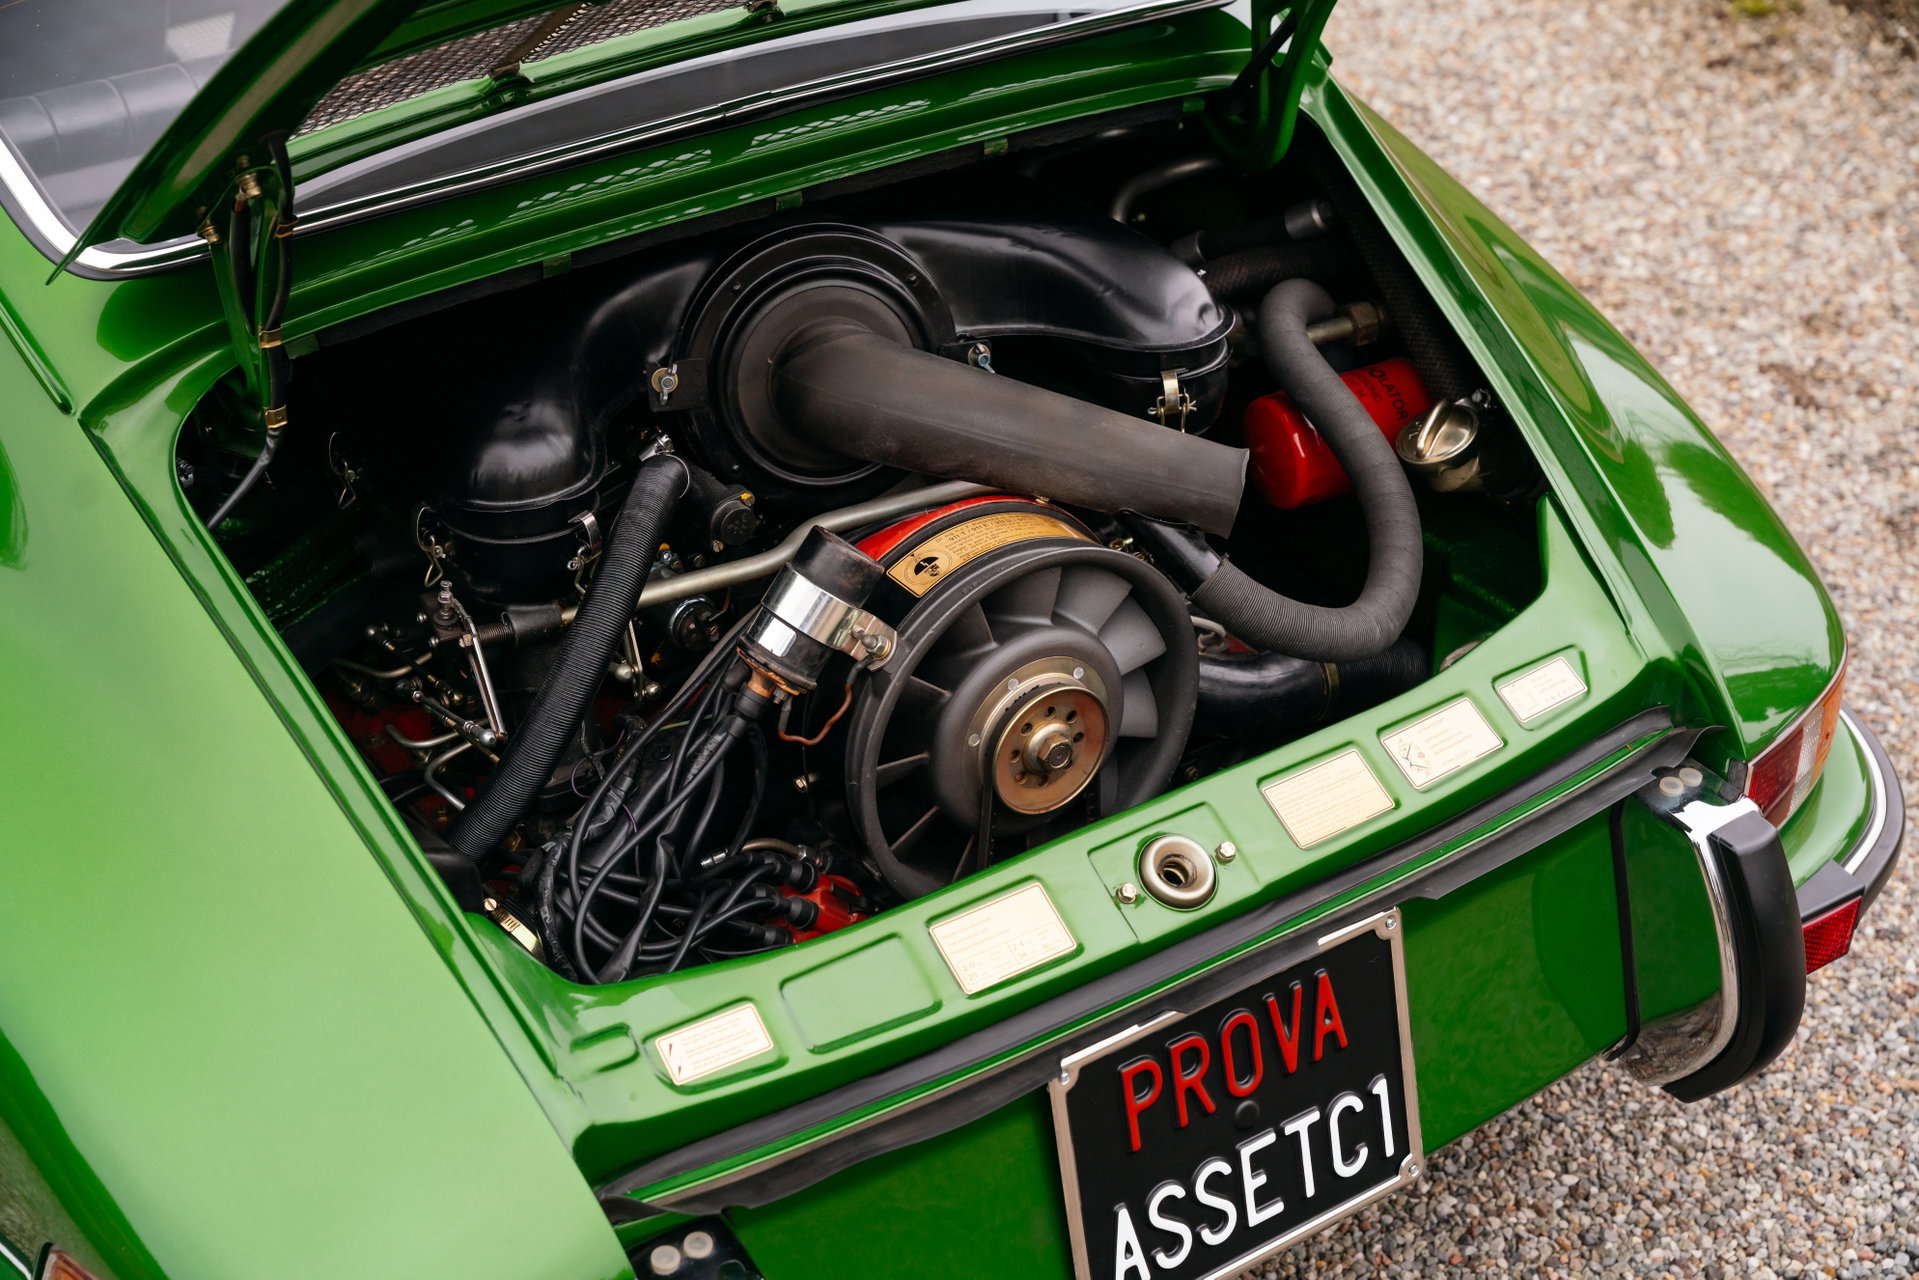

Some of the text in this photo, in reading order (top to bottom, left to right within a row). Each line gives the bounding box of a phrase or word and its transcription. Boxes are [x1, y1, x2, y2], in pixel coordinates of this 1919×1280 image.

[1369, 368, 1409, 421] OLATOR
[1118, 968, 1349, 1151] PROVA
[1115, 1074, 1395, 1280] ASSETC1
